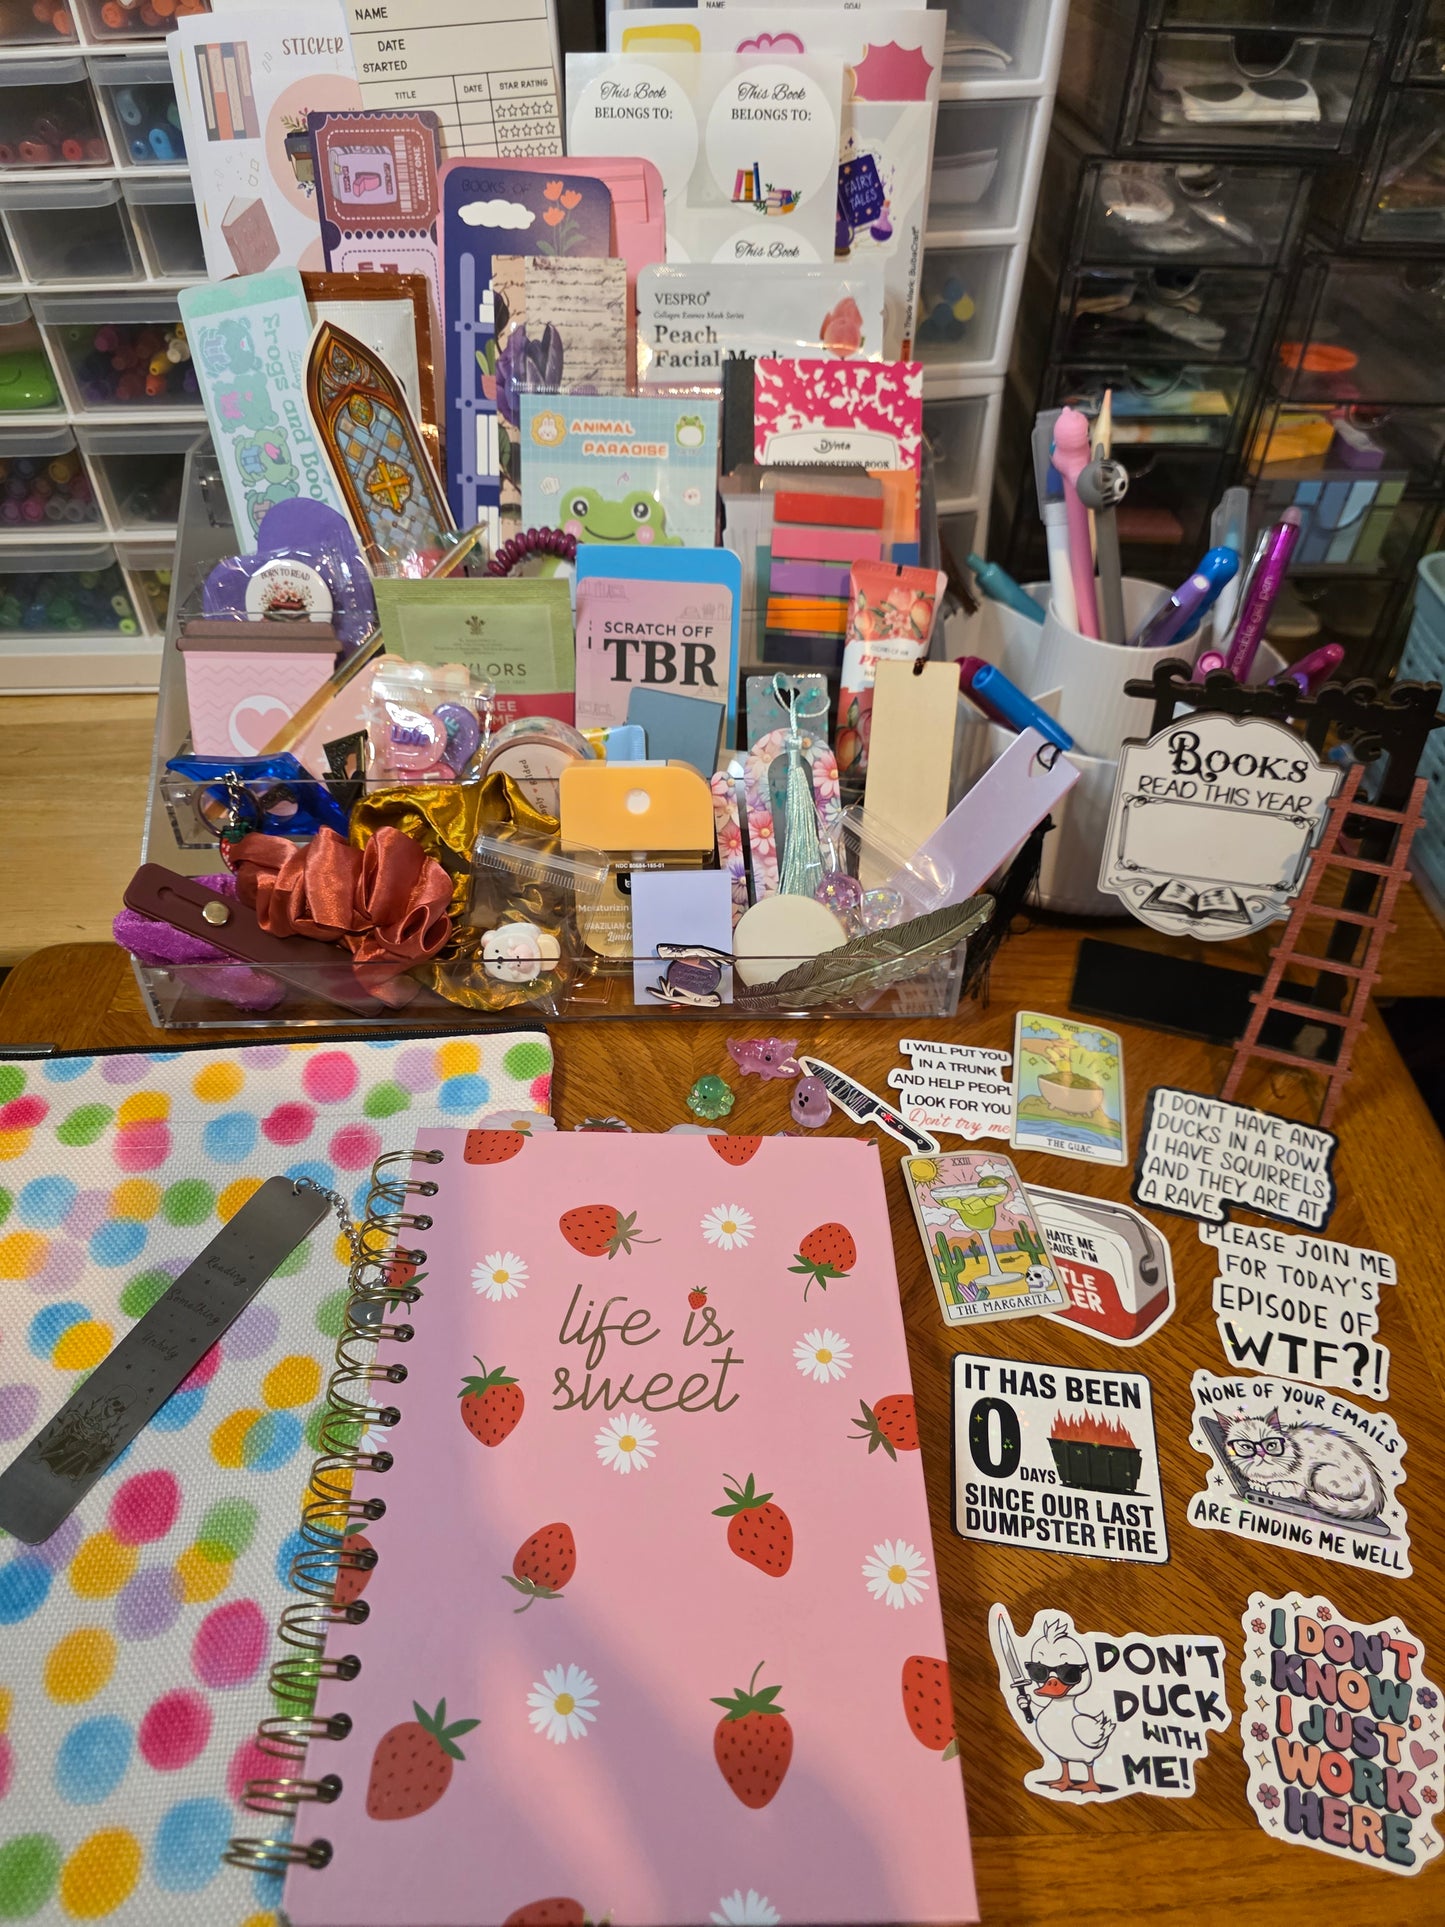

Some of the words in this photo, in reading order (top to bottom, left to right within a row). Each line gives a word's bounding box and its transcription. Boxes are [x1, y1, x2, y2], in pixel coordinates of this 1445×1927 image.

[355, 7, 388, 20] NAME
[706, 1, 726, 9] NAME
[282, 36, 344, 56] STICKER
[378, 38, 406, 52] DATE
[363, 60, 408, 74] STARTED
[395, 90, 416, 100] TITLE
[463, 83, 483, 94] DATE
[499, 80, 518, 91] STAR
[520, 77, 548, 90] RATING
[600, 81, 632, 101] This
[633, 83, 667, 100] Book
[737, 82, 768, 101] This
[770, 84, 807, 101] Book
[594, 107, 651, 121] BELONGS
[654, 107, 673, 120] TO:
[731, 108, 788, 121] BELONGS
[790, 108, 812, 121] TO:
[413, 146, 423, 168] ONE
[415, 169, 426, 201] ADMIT
[461, 178, 506, 194] BOOKS
[845, 172, 872, 197] FAIRY
[850, 188, 877, 211] TALES
[735, 240, 765, 258] This
[766, 242, 800, 258] Book
[654, 324, 719, 344] Peach
[654, 350, 720, 368] Facial
[262, 313, 289, 392] Frogs
[284, 400, 313, 445] and
[570, 420, 634, 436] ANIMAL
[280, 568, 290, 577] TO
[291, 569, 311, 581] READ
[1259, 575, 1273, 601] pen
[604, 621, 676, 637] SCRATCH
[682, 625, 714, 638] OFF
[603, 638, 719, 687] TBR
[1138, 775, 1198, 799] READ
[1203, 784, 1249, 806] THIS
[1256, 790, 1313, 814] YEAR
[578, 903, 630, 912] Moisturizin
[906, 1042, 910, 1050] I
[913, 1043, 947, 1055] WILL
[950, 1047, 976, 1058] PUT
[979, 1050, 1008, 1062] YOU
[919, 1058, 933, 1069] IN
[936, 1061, 946, 1071] A
[949, 1062, 997, 1076] TRUNK
[893, 1073, 925, 1086] AND
[928, 1076, 965, 1090] HELP
[968, 1081, 1012, 1096] PEOPL
[906, 1094, 946, 1108] LOOK
[949, 1098, 978, 1112] FOR
[981, 1102, 1011, 1115] YOU
[908, 1107, 952, 1127] Don't
[955, 1117, 983, 1136] try
[1159, 1092, 1166, 1107] I
[1172, 1094, 1228, 1123] DON'T
[1235, 1110, 1283, 1139] HAVE
[1289, 1126, 1329, 1153] ANY
[1047, 1138, 1065, 1149] THE
[1068, 1142, 1096, 1155] GUAC.
[1157, 1112, 1222, 1145] DUCKS
[1229, 1130, 1249, 1152] IN
[1254, 1139, 1267, 1157] A
[1274, 1144, 1324, 1176] ROW.
[951, 1156, 972, 1167] XXIII
[1151, 1133, 1159, 1151] I
[1165, 1139, 1215, 1166] HAVE
[1220, 1152, 1326, 1199] SQUIRRELS
[1143, 1179, 1157, 1199] A
[1164, 1184, 1219, 1217] RAVE.
[1148, 1156, 1189, 1181] AND
[1197, 1166, 1248, 1199] THEY
[1253, 1184, 1289, 1213] ARE
[1297, 1200, 1322, 1222] AT
[1045, 1228, 1075, 1247] HATE
[1077, 1236, 1096, 1252] ME
[1205, 1225, 1287, 1255] PLEASE
[1295, 1239, 1350, 1267] JOIN
[1360, 1252, 1392, 1279] ME
[1080, 1250, 1099, 1264] I'M
[1226, 1254, 1267, 1280] FOR
[1277, 1263, 1374, 1301] TODAY'S
[956, 1303, 979, 1316] THE
[983, 1293, 1056, 1312] MARGARITA.
[1070, 1288, 1106, 1315] ER
[1219, 1283, 1328, 1330] EPISODE
[1340, 1311, 1373, 1337] OF
[558, 1283, 661, 1371] life
[682, 1288, 735, 1347] is
[1223, 1321, 1384, 1395] WTF?!
[552, 1346, 745, 1412] sweet
[964, 1363, 991, 1392] IT
[999, 1366, 1058, 1399] HAS
[1066, 1376, 1142, 1410] BEEN
[1196, 1383, 1247, 1407] NONE
[1252, 1382, 1274, 1398] OF
[1281, 1384, 1326, 1413] YOUR
[1331, 1397, 1400, 1454] EMAILS
[968, 1396, 1022, 1479] 0
[1020, 1466, 1057, 1485] DAYS
[965, 1483, 1038, 1515] SINCE
[1041, 1490, 1091, 1521] OUR
[1095, 1498, 1155, 1529] LAST
[966, 1507, 1097, 1548] DUMPSTER
[1102, 1524, 1159, 1555] FIRE
[1193, 1499, 1230, 1524] ARE
[1238, 1509, 1314, 1547] FINDING
[1318, 1530, 1347, 1556] ME
[1351, 1540, 1406, 1571] WELL
[1269, 1608, 1287, 1648] I
[1294, 1613, 1419, 1682] DON'T
[1094, 1641, 1220, 1679] DON'T
[1113, 1683, 1227, 1723] DUCK
[1142, 1720, 1203, 1752] WITH
[1276, 1694, 1294, 1737] I
[1298, 1704, 1407, 1765] JUST
[1122, 1754, 1191, 1789] ME!
[1271, 1735, 1423, 1818] WORK
[1283, 1786, 1416, 1867] HERE
